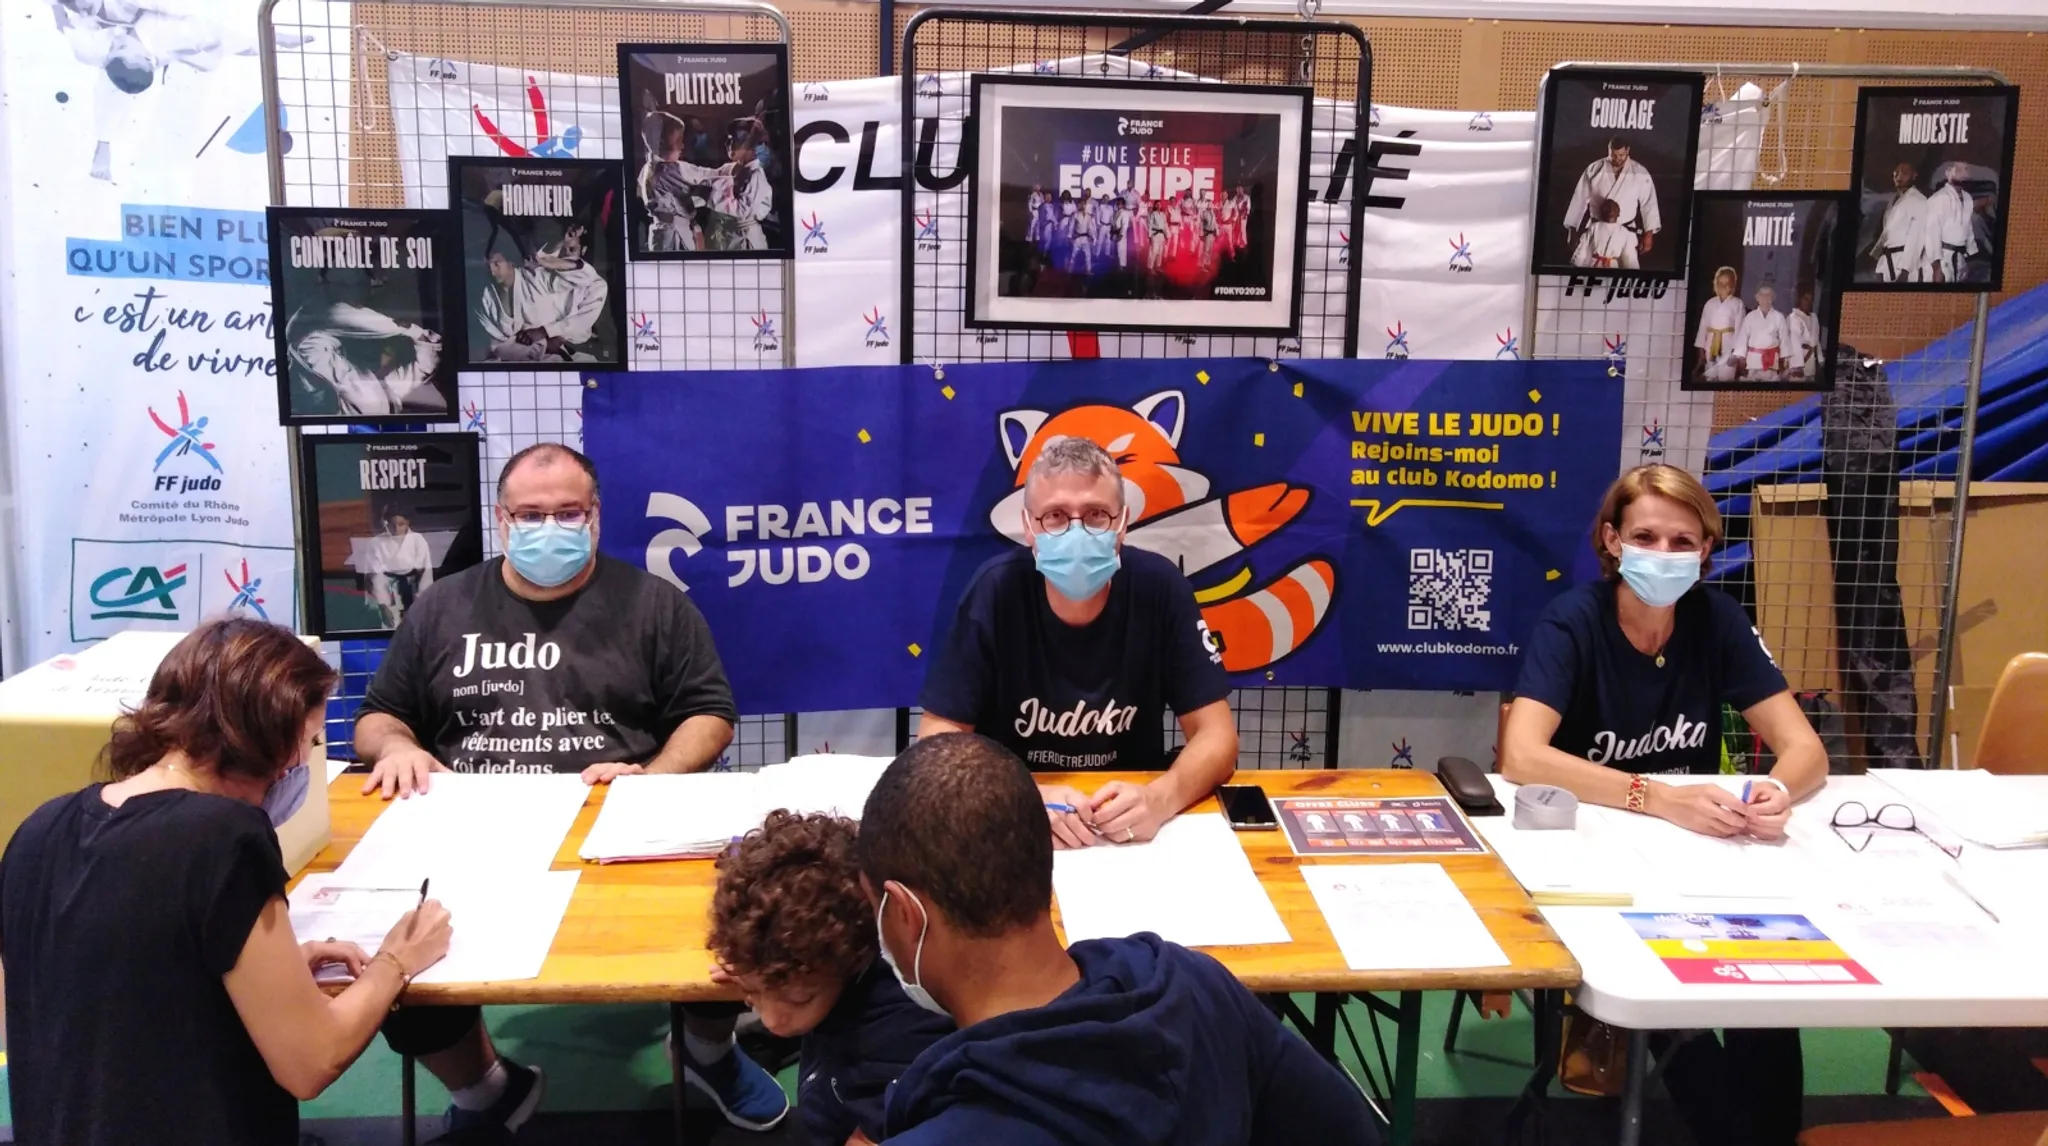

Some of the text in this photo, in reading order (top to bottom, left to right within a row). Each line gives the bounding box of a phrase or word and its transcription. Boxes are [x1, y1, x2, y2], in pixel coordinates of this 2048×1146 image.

[429, 70, 457, 80] FF udo
[664, 72, 743, 105] POLITESSE
[803, 93, 813, 102] FF
[1608, 83, 1631, 91] FRANCE
[1130, 119, 1164, 129] FRANCE
[1590, 97, 1656, 131] COURAGE
[1130, 127, 1153, 136] JUDO
[1898, 113, 1971, 145] MODESTIE
[794, 119, 968, 194] CLU
[1081, 145, 1192, 166] #UNE SEULE
[517, 169, 543, 177] FRANCE
[1059, 164, 1216, 201] EQUIPE
[502, 183, 574, 217] HONNEUR
[124, 213, 202, 241] BIEN
[340, 220, 367, 228] FRANCE
[1742, 212, 1796, 247] AMITIÉ
[290, 232, 433, 270] CONTRÔLE DE SOI
[803, 246, 813, 254] FF
[918, 243, 927, 252] FF
[68, 248, 270, 281] QU'UN SPOR
[1449, 264, 1458, 272] FF
[1213, 286, 1267, 297] #TOKYO2020
[73, 285, 168, 334] c'est
[167, 305, 216, 334] un
[133, 328, 279, 378] de vivre
[866, 341, 875, 349] FF
[1351, 411, 1420, 435] VIVE
[1428, 412, 1461, 436] LE
[1469, 413, 1544, 437] JUDO
[1351, 440, 1500, 464] Rejoins-moi
[154, 474, 222, 495] FF judo
[359, 458, 427, 491] RESPECT
[1351, 469, 1380, 486] au
[1386, 467, 1438, 487] club
[1445, 470, 1544, 490] Kodomo
[130, 499, 241, 512] Comité du Rhône
[118, 512, 250, 527] Métropole Lyon Judo
[725, 496, 934, 543] FRANCE
[726, 542, 871, 589] JUDO
[452, 631, 562, 679] Judo
[1376, 641, 1520, 657] www.clubkodomo.fr
[452, 683, 479, 698] nom
[510, 706, 537, 727] de
[540, 706, 588, 731] plier
[1013, 697, 1139, 738] Judoka
[461, 731, 606, 753] vêtements avec
[1586, 713, 1709, 766] Judoka
[452, 757, 475, 775] toi
